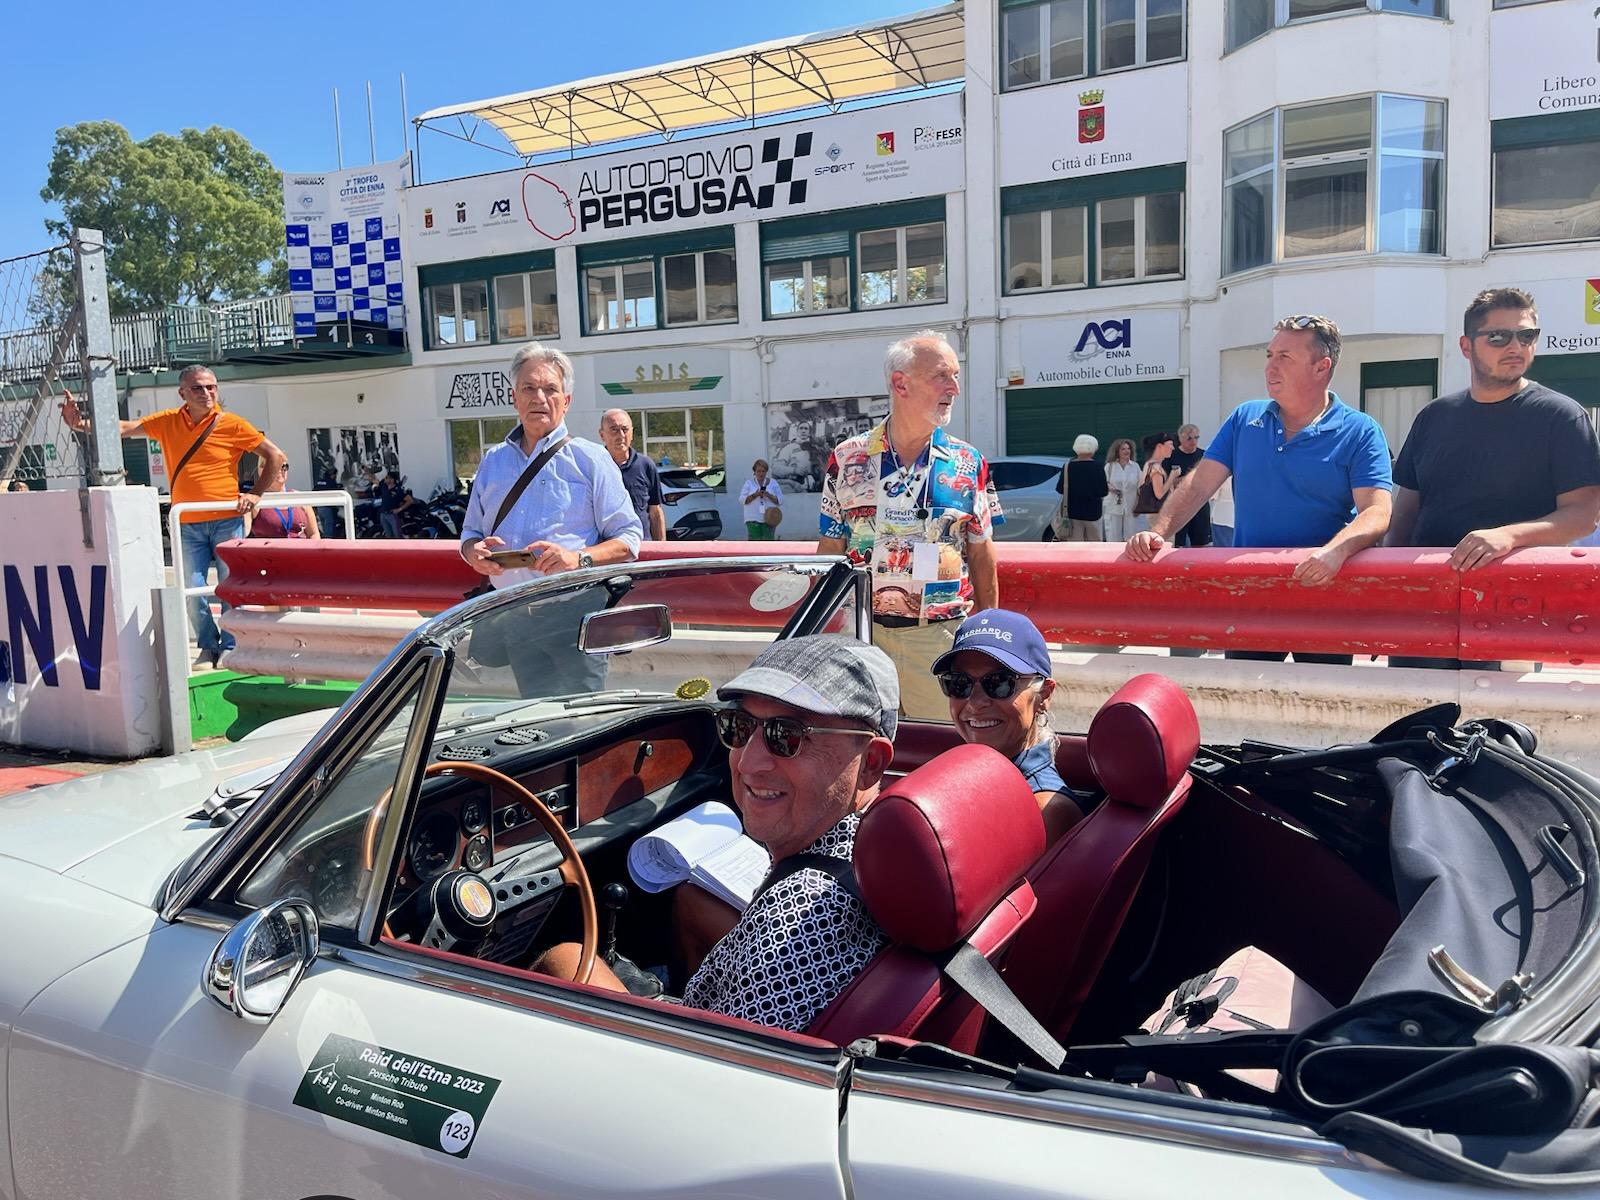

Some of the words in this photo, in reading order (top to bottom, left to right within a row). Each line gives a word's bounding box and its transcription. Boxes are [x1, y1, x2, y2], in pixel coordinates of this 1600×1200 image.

[1543, 76, 1596, 92] Libero
[936, 127, 962, 140] FESR
[577, 144, 753, 198] AUTODROMO
[814, 162, 855, 176] SPORT
[1051, 156, 1082, 173] Città
[1084, 152, 1097, 168] di
[1100, 151, 1132, 165] Enna
[353, 174, 379, 185] TROFEO
[359, 186, 367, 194] DI
[367, 182, 385, 192] ENNA
[579, 175, 758, 232] PERGUSA
[1074, 318, 1131, 352] ACI
[1106, 349, 1131, 359] ENNA
[1036, 366, 1101, 382] Automobile
[1104, 364, 1132, 378] Club
[1135, 363, 1165, 376] Enna
[359, 1047, 393, 1069] Raid
[392, 1056, 453, 1086] dell'Etna
[452, 1075, 486, 1095] 2023
[368, 1067, 400, 1085] Porsche
[400, 1076, 429, 1093] Tribute
[341, 1083, 361, 1096] Driver
[390, 1098, 405, 1110] Rob
[335, 1096, 364, 1112] Co-driver
[385, 1111, 409, 1126] Sharon
[446, 1120, 471, 1142] 123
